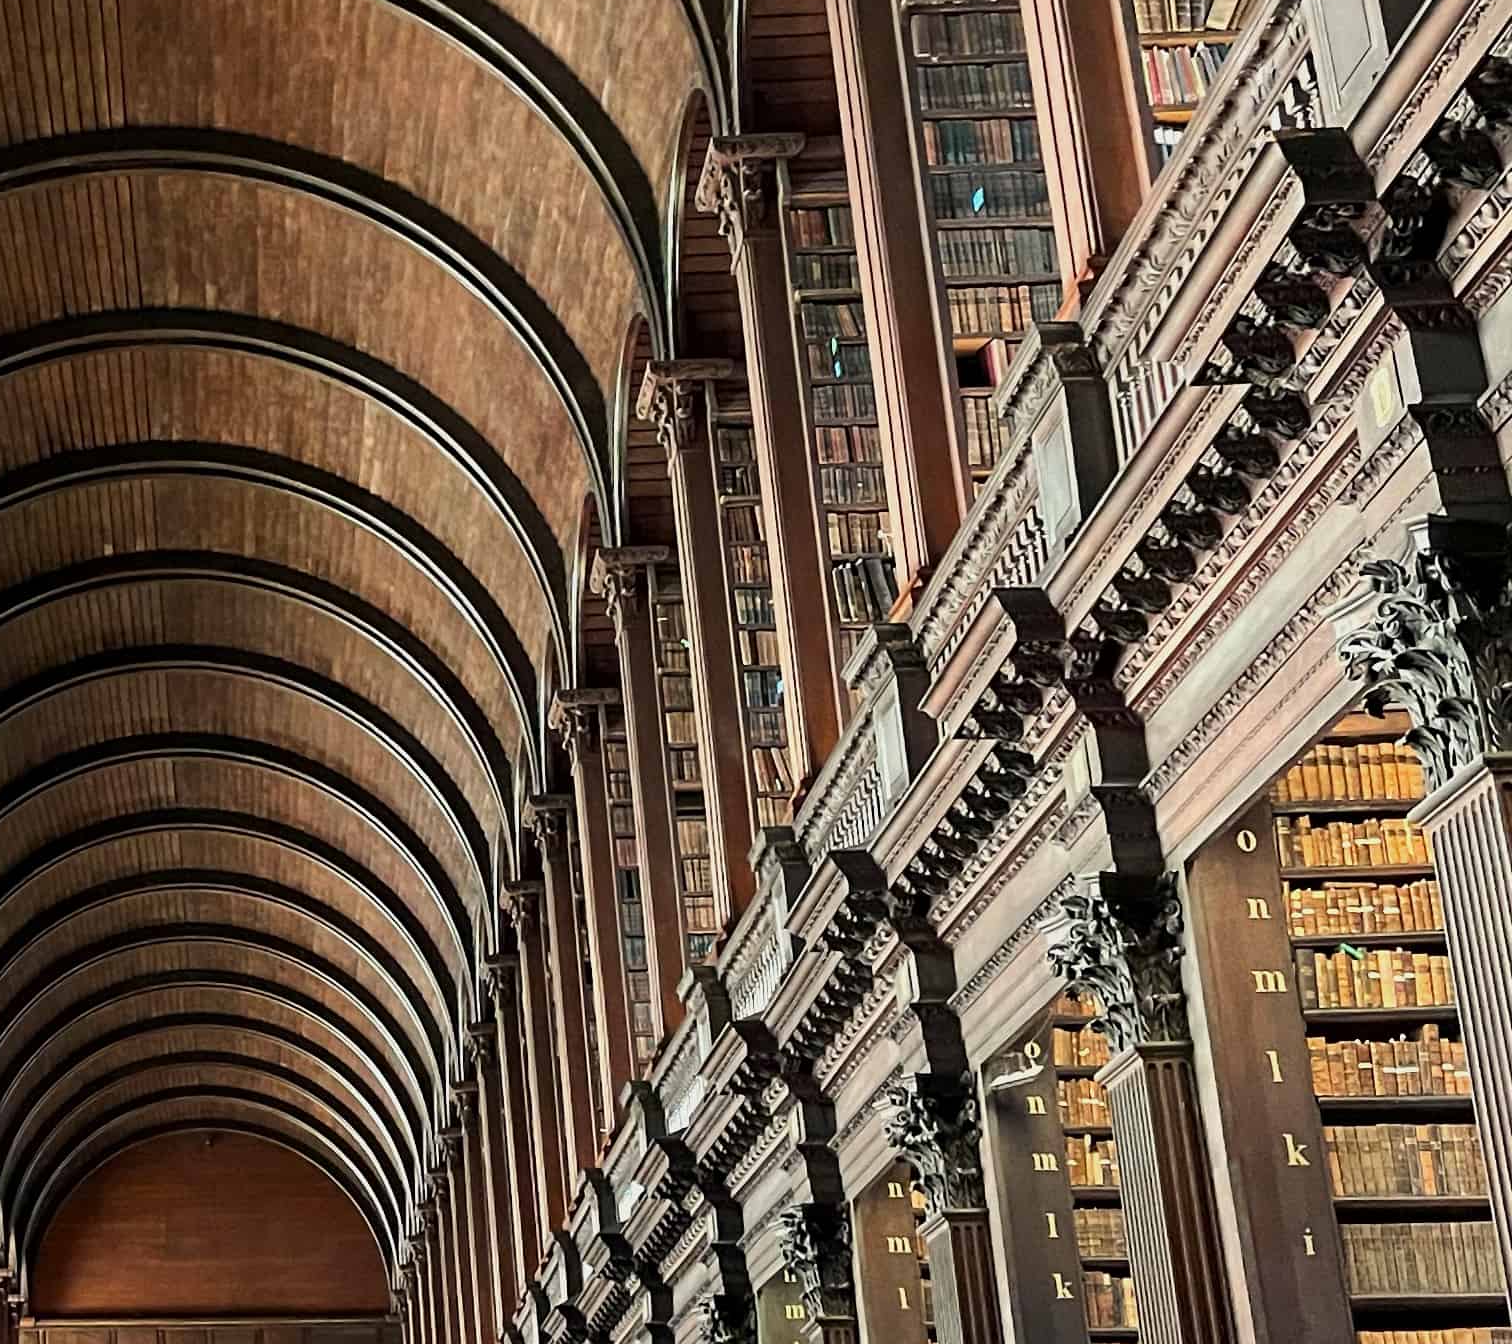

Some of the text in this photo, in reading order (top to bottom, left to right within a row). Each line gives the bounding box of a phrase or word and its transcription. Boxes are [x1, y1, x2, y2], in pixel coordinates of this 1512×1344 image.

[1236, 829, 1257, 853] o
[1246, 897, 1272, 920] n
[1250, 969, 1288, 993] m
[1024, 1041, 1041, 1059] o
[1264, 1050, 1284, 1083] l
[1026, 1095, 1047, 1114] n
[1031, 1152, 1059, 1171] m
[1282, 1134, 1311, 1166] k
[887, 1182, 904, 1198] n
[1044, 1212, 1059, 1239] l
[886, 1236, 912, 1253] m
[1302, 1227, 1316, 1256] i
[1052, 1272, 1074, 1299] k
[898, 1287, 911, 1310] l
[784, 1304, 806, 1320] m
